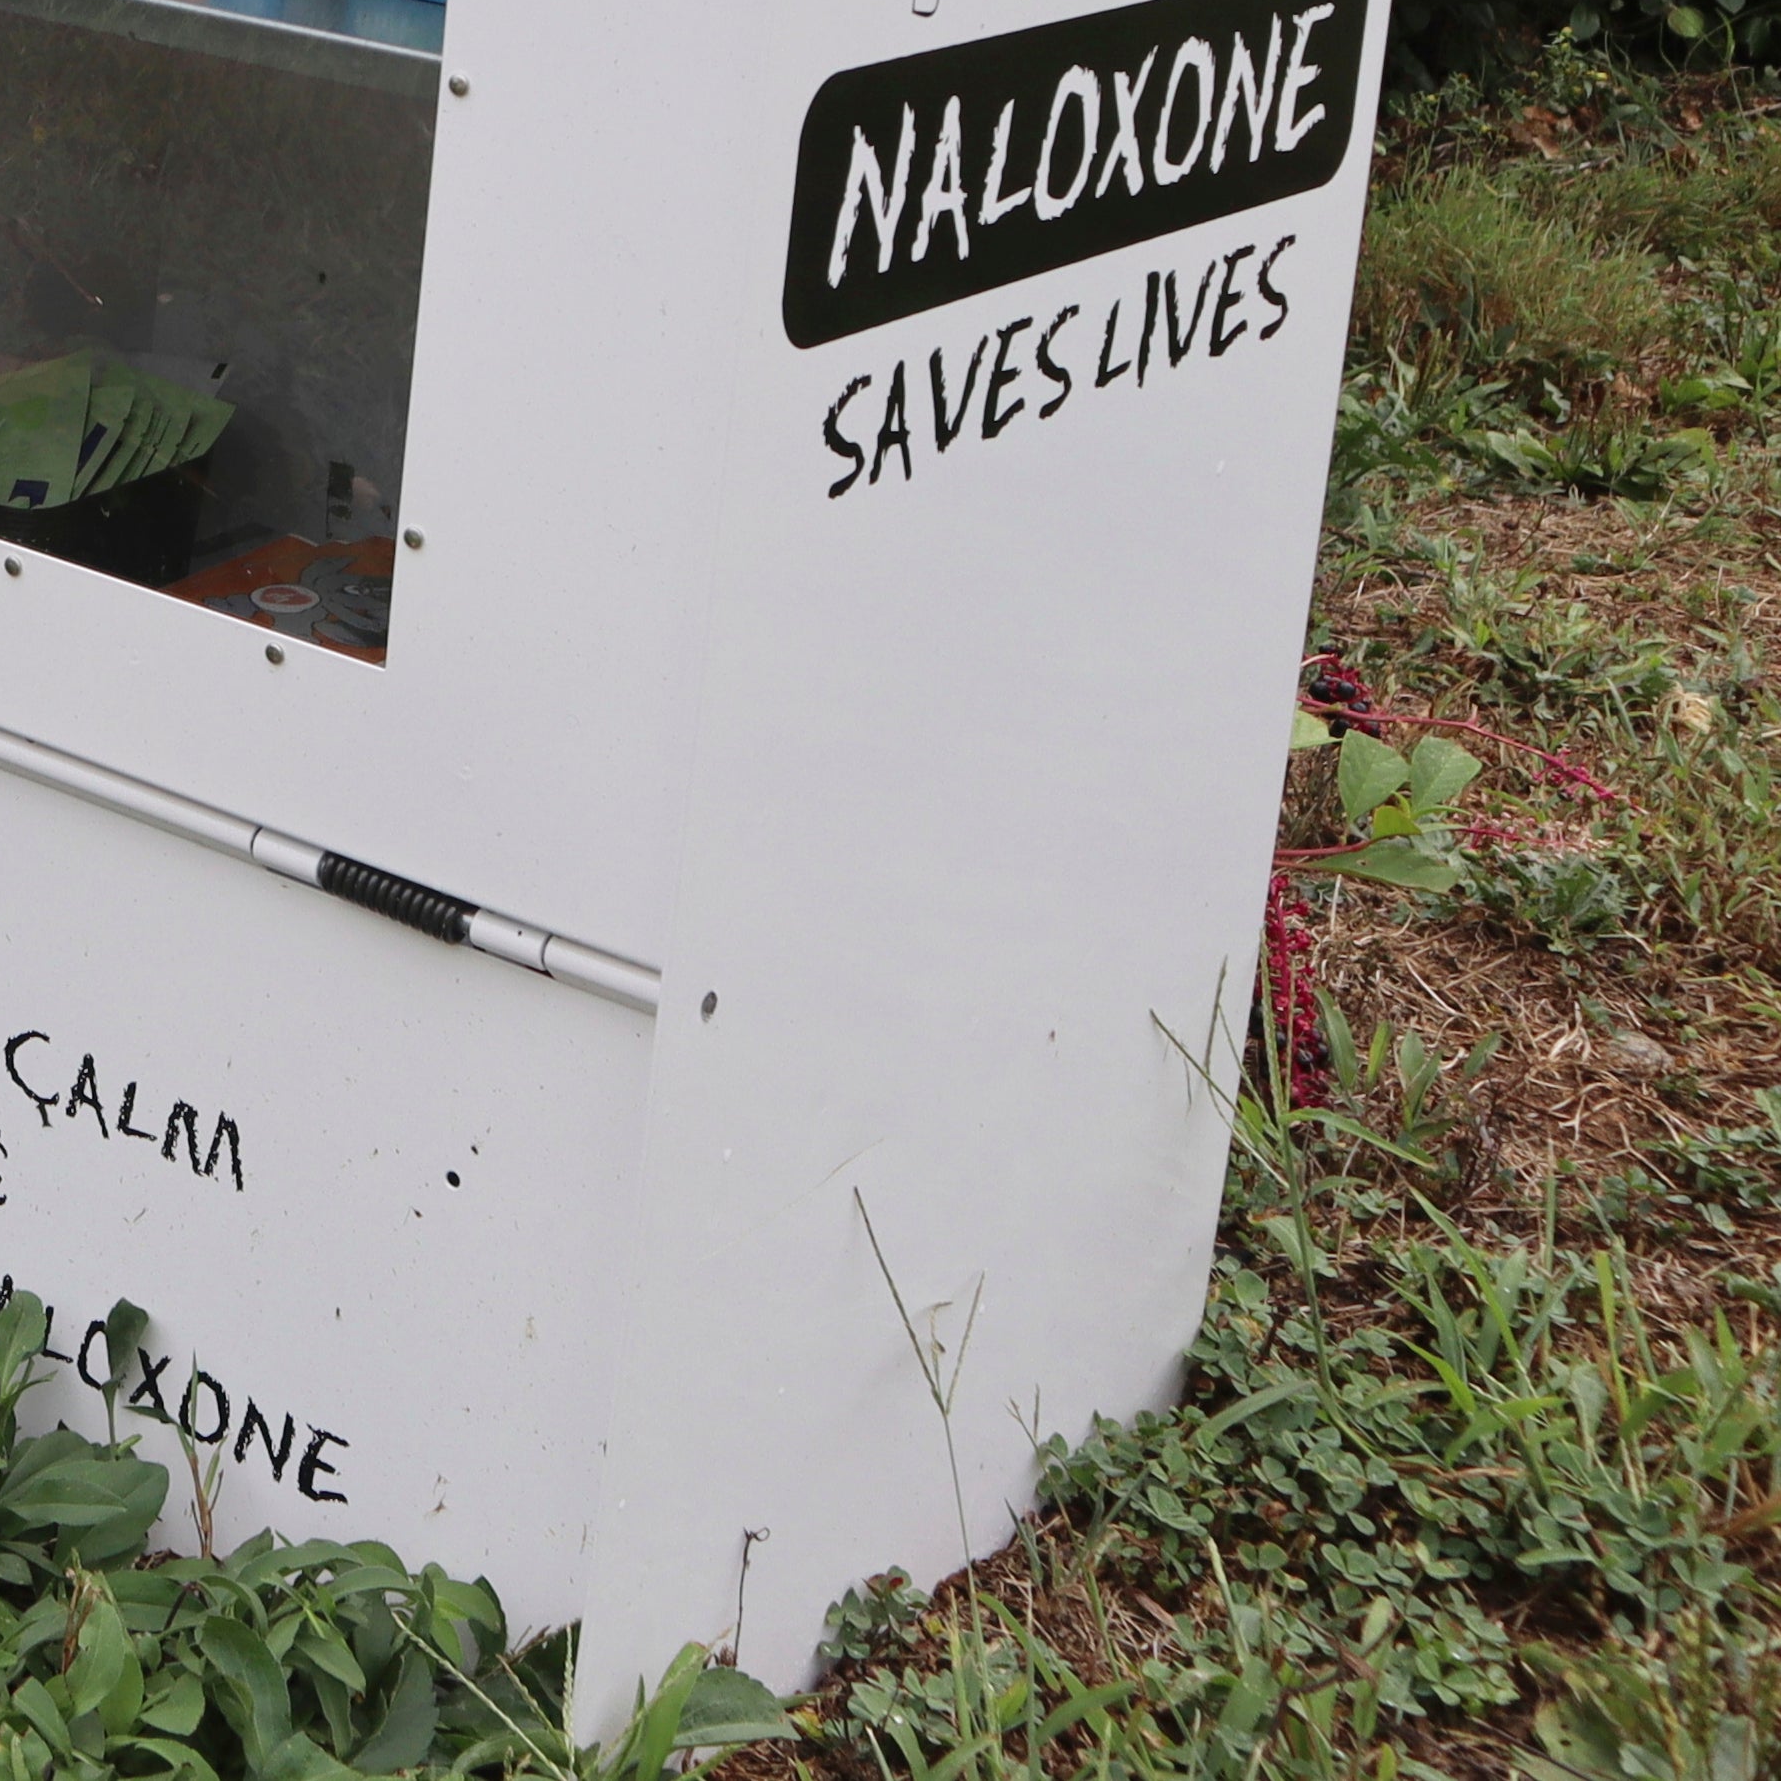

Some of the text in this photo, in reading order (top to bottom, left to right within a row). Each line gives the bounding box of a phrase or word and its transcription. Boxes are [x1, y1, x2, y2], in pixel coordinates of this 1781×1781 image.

[826, 1, 1335, 289] NALOXONE
[822, 233, 1298, 500] SAVES LIVES
[3, 1030, 245, 1192] CALM
